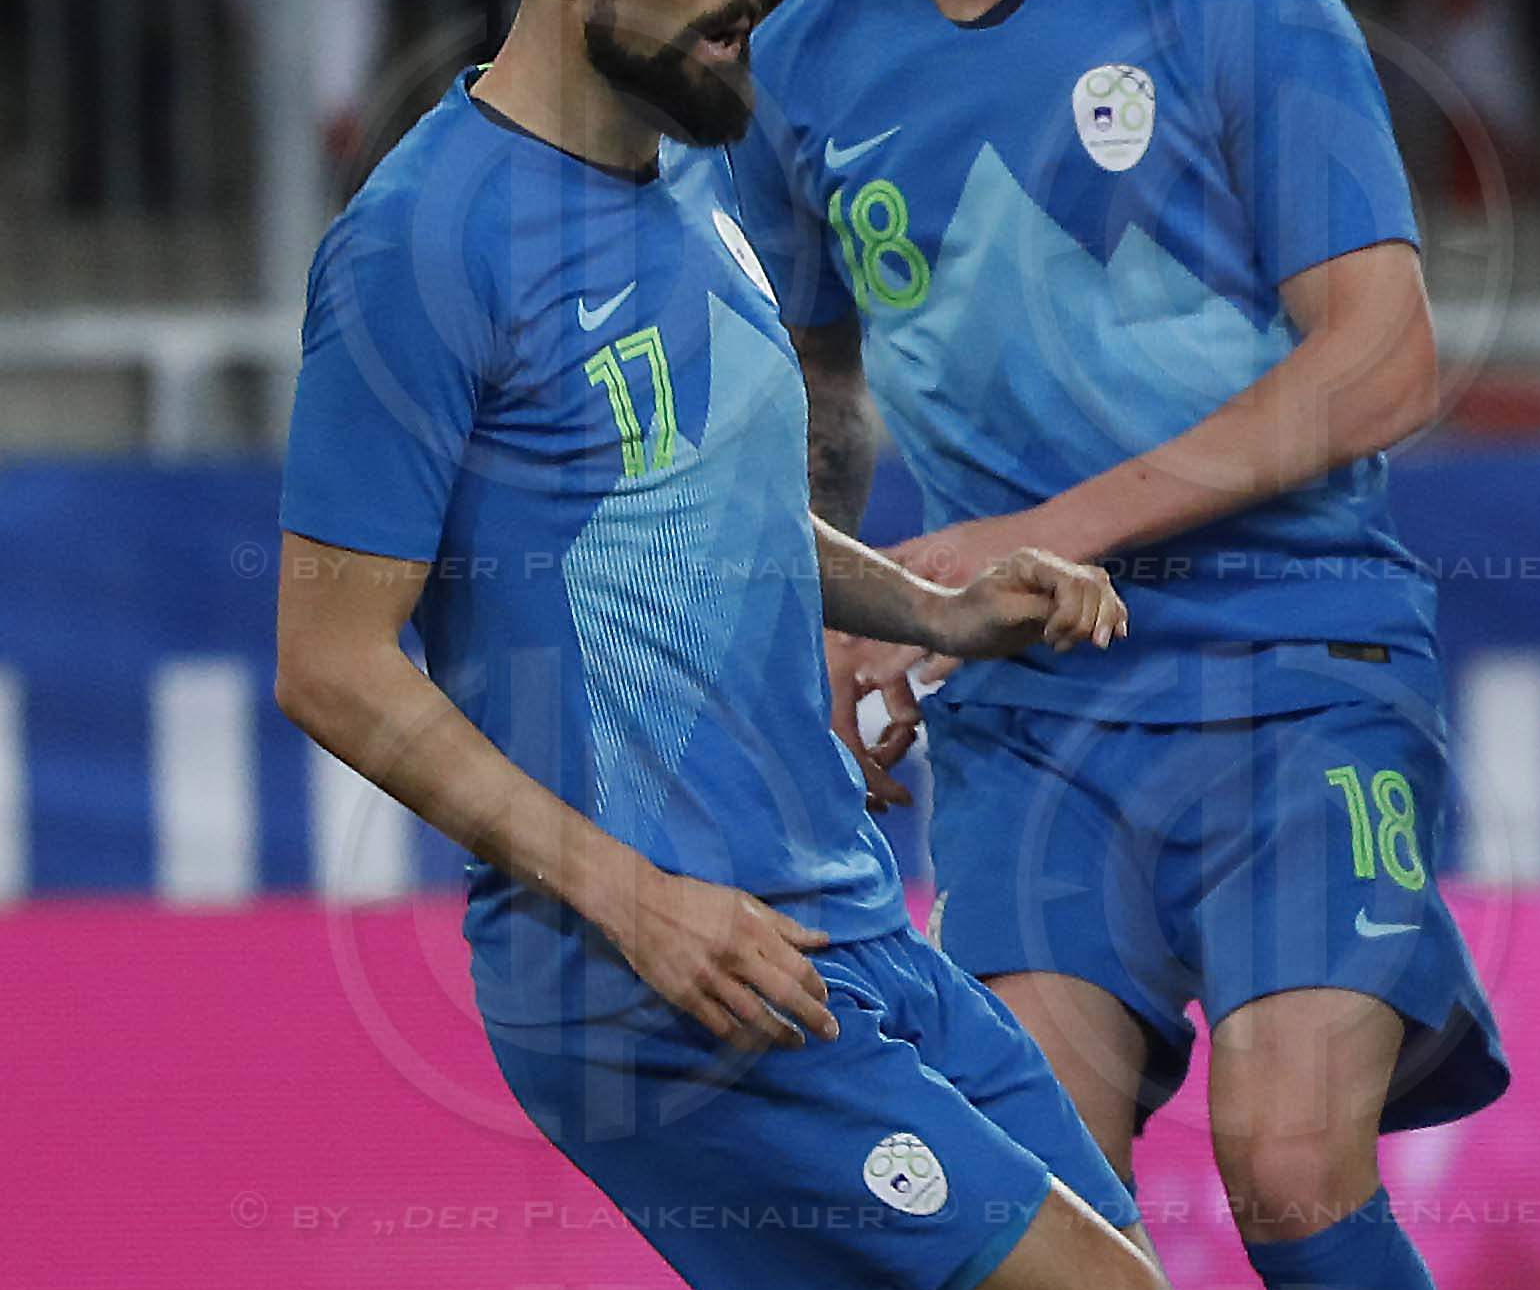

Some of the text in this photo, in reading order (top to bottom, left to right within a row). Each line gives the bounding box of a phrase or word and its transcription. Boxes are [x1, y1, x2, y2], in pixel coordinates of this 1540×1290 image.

[828, 178, 931, 311] 18
[584, 326, 677, 478] 17
[1325, 765, 1426, 891] 18
